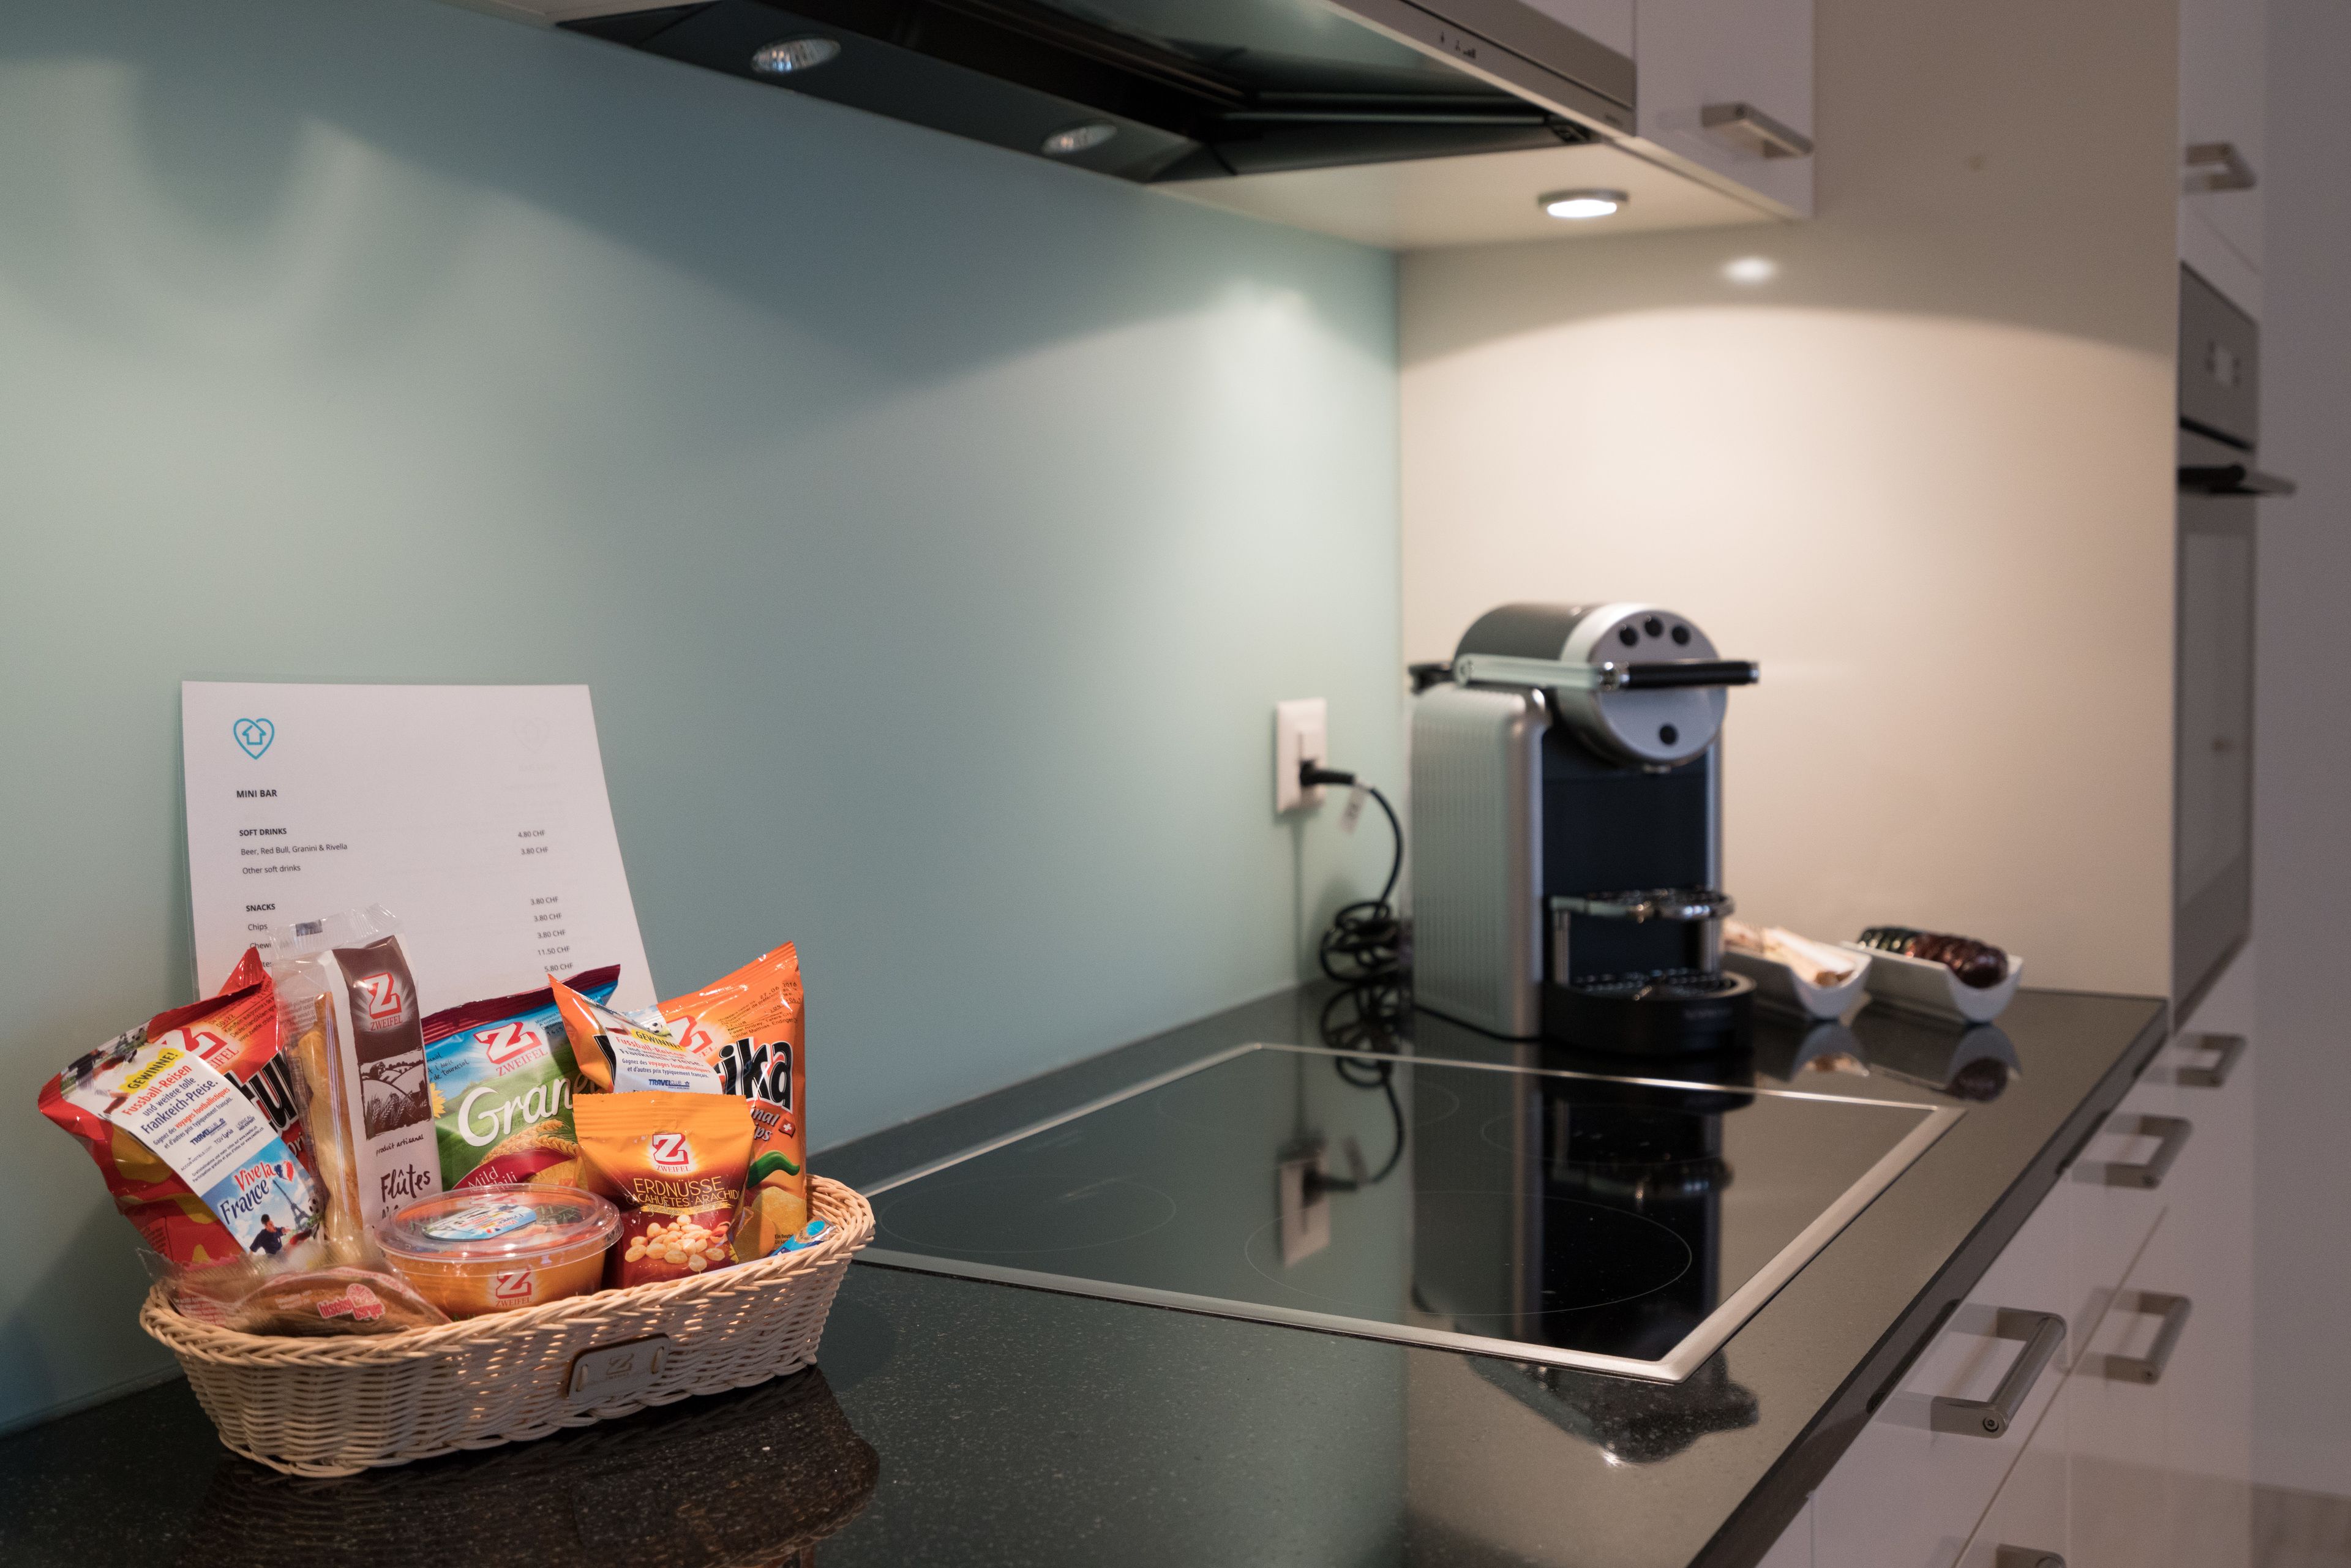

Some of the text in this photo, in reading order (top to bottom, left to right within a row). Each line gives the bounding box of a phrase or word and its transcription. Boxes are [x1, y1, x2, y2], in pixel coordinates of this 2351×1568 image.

[246, 903, 276, 912] SNACKS
[248, 923, 268, 931] Chips
[362, 972, 402, 1019] Z
[370, 1015, 402, 1031] ZWEIFEL
[473, 1021, 542, 1064] Z
[636, 1031, 683, 1050] GEWINNE!
[127, 1052, 179, 1089] GEWINNE!
[210, 1047, 239, 1070] EIFEL
[495, 1048, 549, 1077] ZWEIFEL
[121, 1064, 192, 1116] Fussball-Reisen
[142, 1076, 196, 1116] und weitere tolle
[141, 1078, 219, 1134] Frankreich-Preise.
[153, 1131, 170, 1146] Gagnez
[174, 1112, 196, 1129] voyages
[193, 1087, 230, 1114] footballistiques
[169, 1133, 185, 1146] d'autres
[192, 1107, 217, 1128] typiquement
[216, 1097, 233, 1110] français.
[376, 1134, 424, 1157] produit artisanal
[652, 1133, 689, 1165] Z
[234, 1161, 276, 1192] Vive la
[381, 1164, 430, 1202] Flûtes
[468, 1166, 499, 1191] Mild
[633, 1176, 724, 1198] ERDNÜSSE
[220, 1179, 269, 1225] France
[626, 1193, 690, 1207] CACAHUÈTES
[496, 1267, 532, 1299] Z
[496, 1297, 532, 1308] ZWEIFEL
